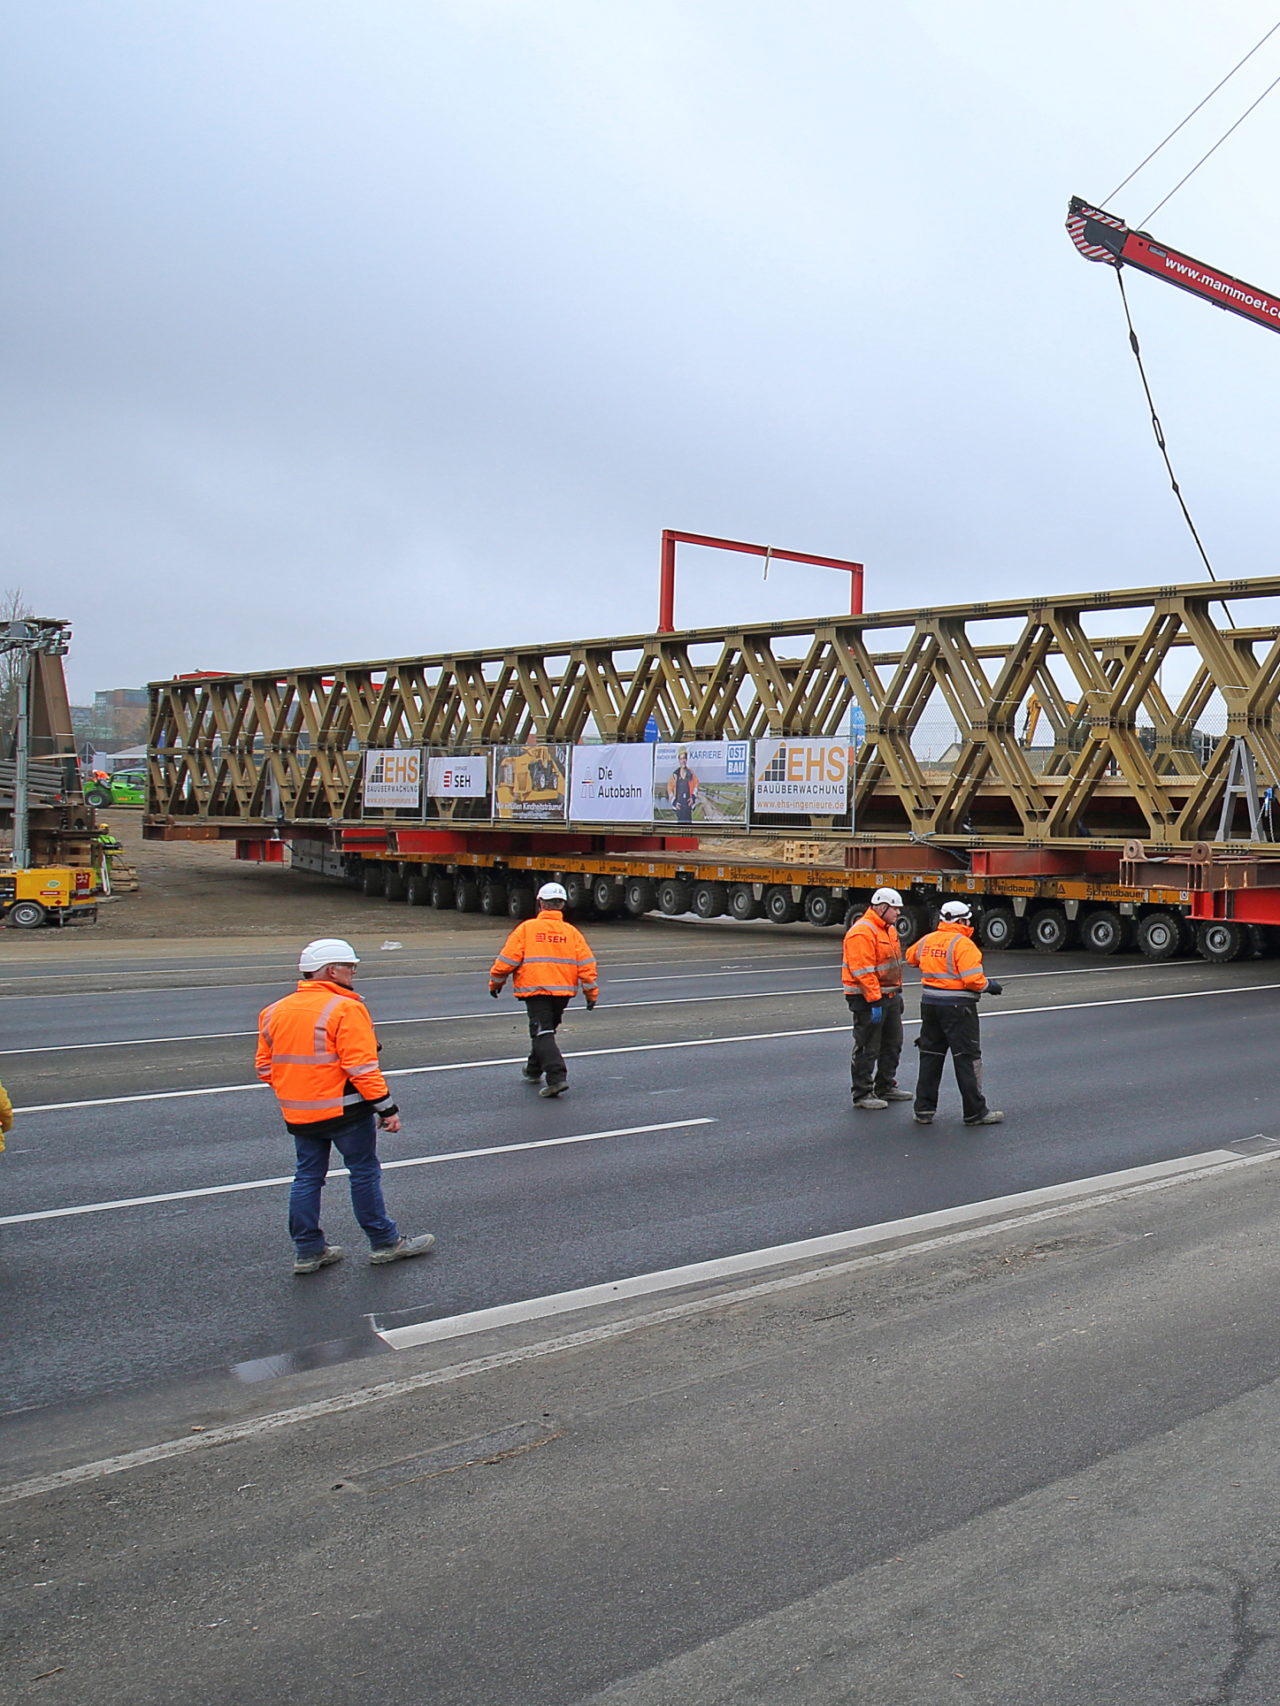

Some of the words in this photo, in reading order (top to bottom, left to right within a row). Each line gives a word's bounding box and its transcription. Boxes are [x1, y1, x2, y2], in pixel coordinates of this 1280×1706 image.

[729, 747, 744, 758] OST
[728, 762, 744, 773] BAU
[787, 746, 845, 782] EHS
[384, 757, 418, 783] EHS
[598, 767, 612, 780] Die
[454, 775, 471, 788] SEH
[598, 785, 642, 798] Autobahn
[757, 783, 844, 794] BAUÜBERWACHUNG
[757, 800, 844, 810] www.ehs-ingenieure.de
[1086, 887, 1145, 898] Schmidbauer
[547, 935, 567, 944] SEH
[931, 949, 947, 958] SEH
